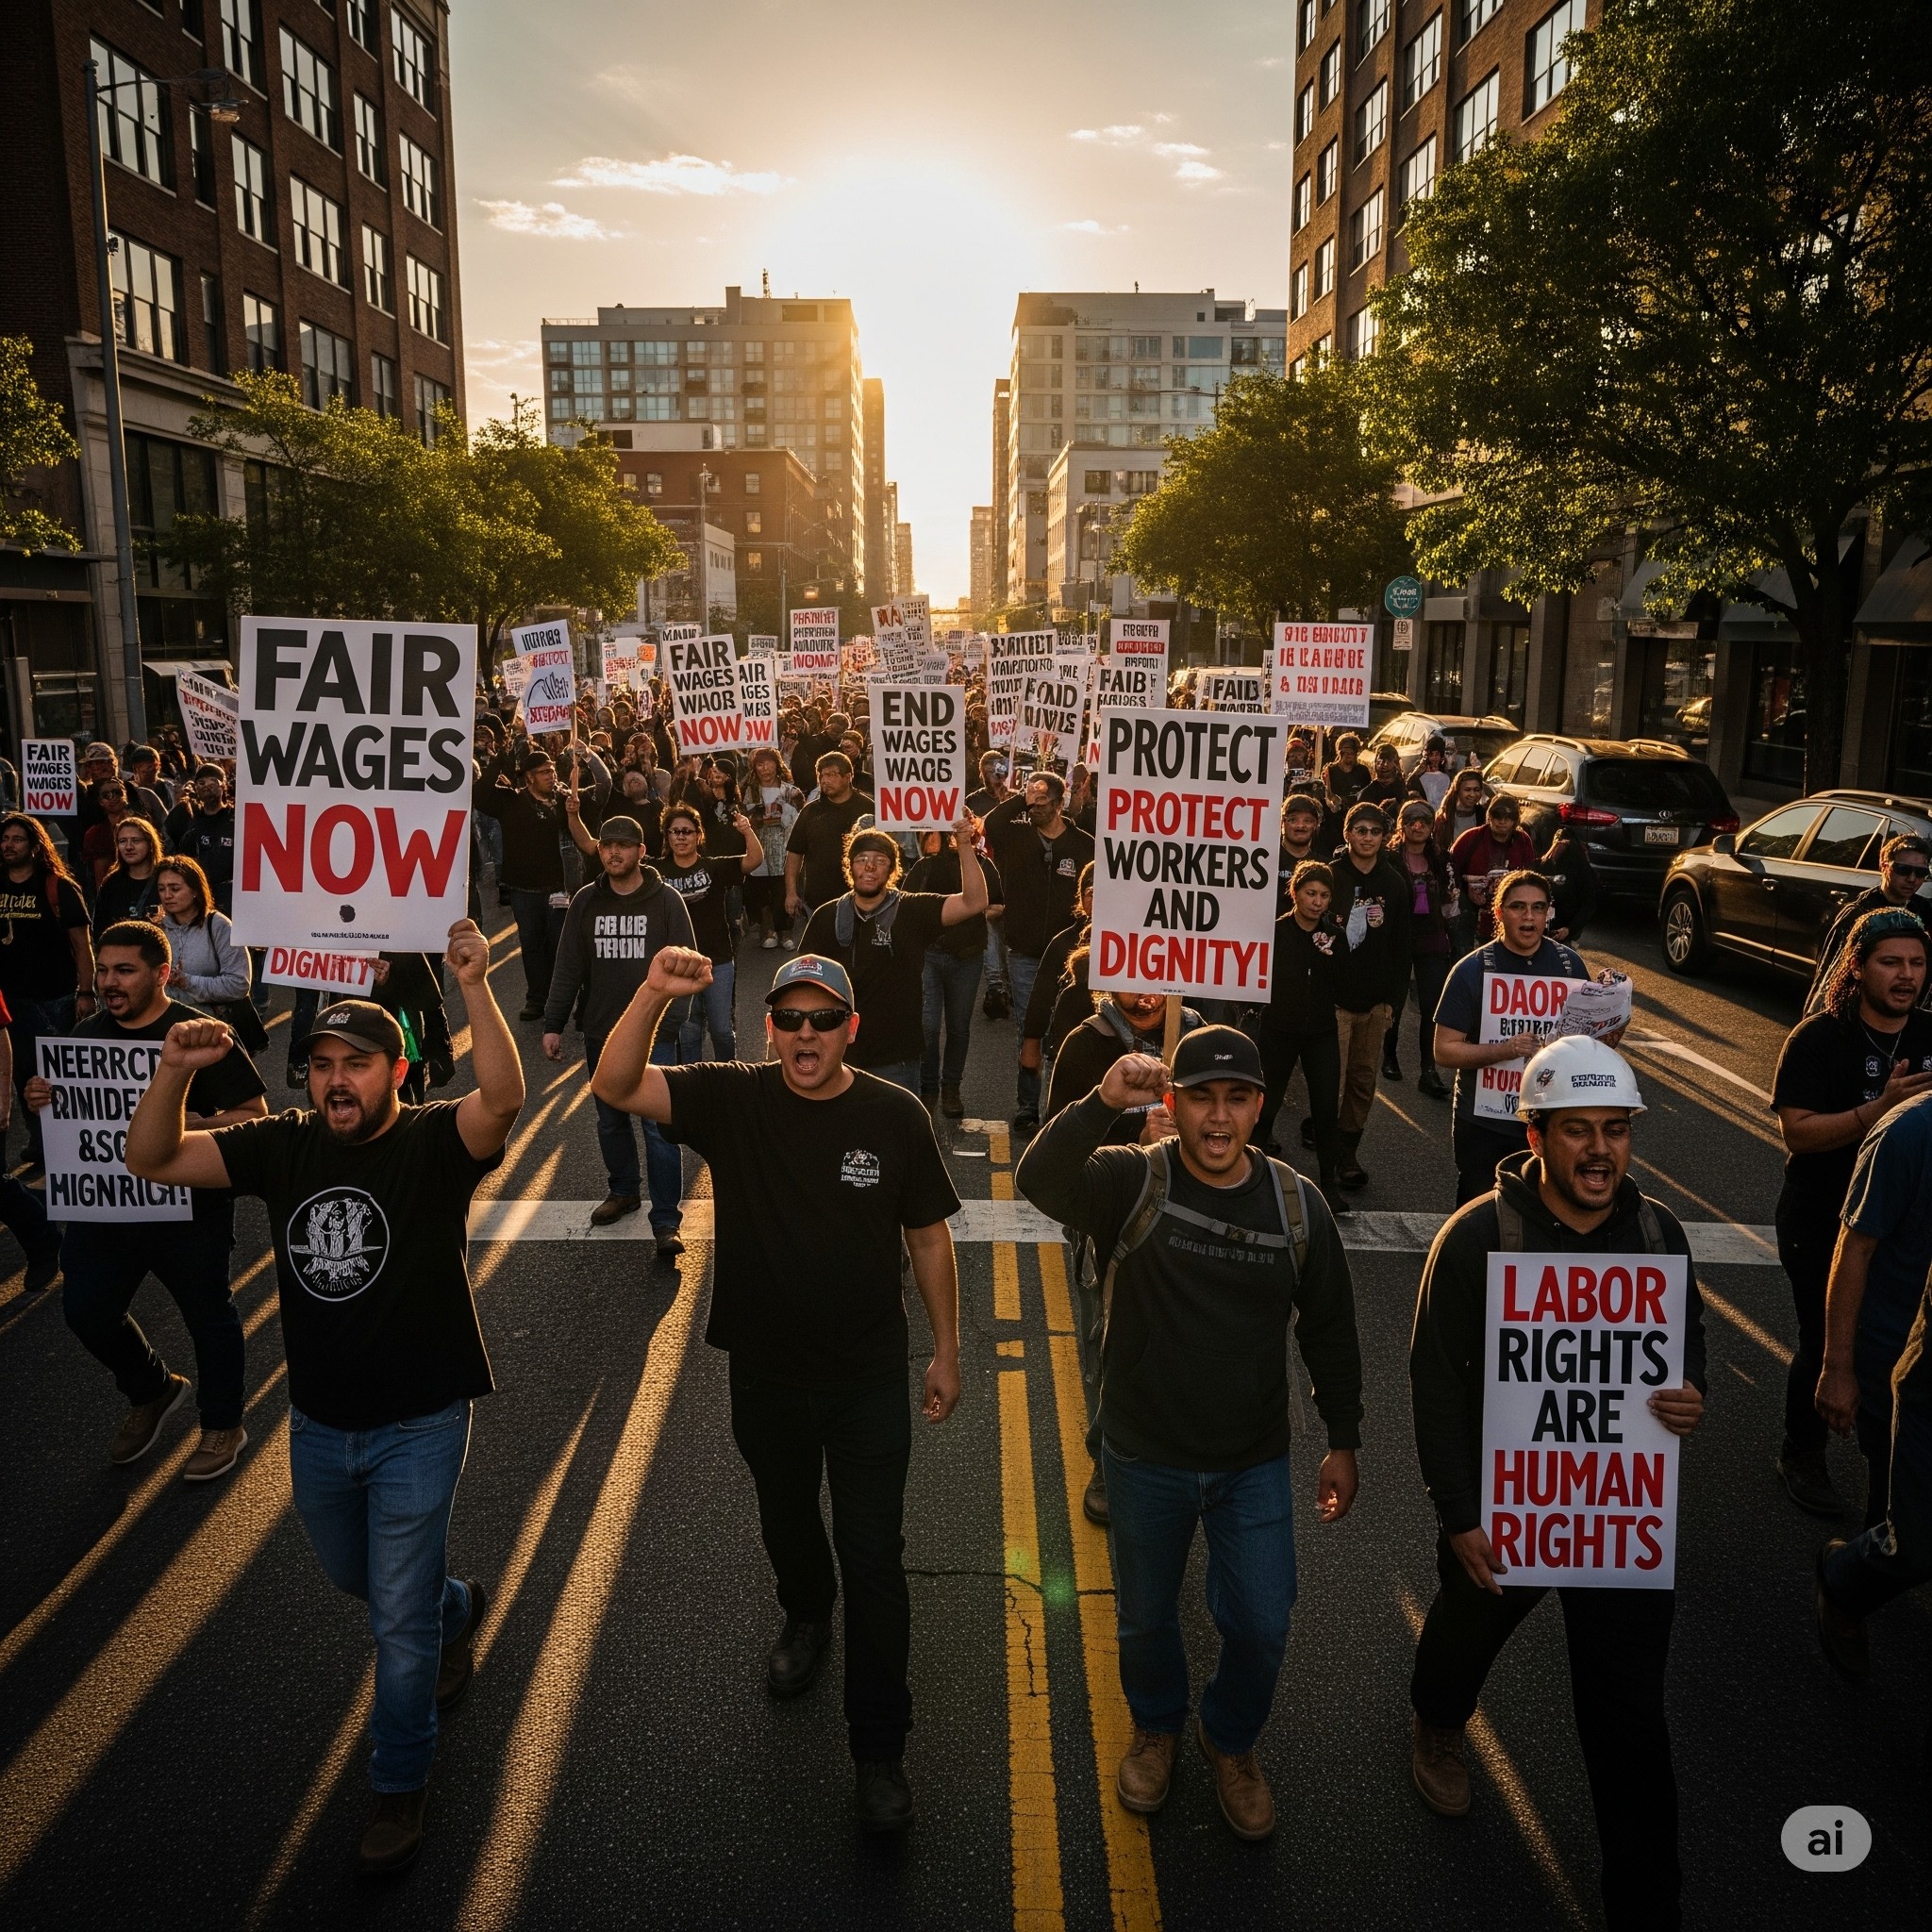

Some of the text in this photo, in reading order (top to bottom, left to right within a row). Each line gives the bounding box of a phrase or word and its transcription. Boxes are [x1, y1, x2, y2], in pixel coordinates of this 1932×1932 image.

[255, 628, 461, 718] FAIR
[669, 641, 731, 671] FAIR
[673, 668, 734, 691] WAGES
[739, 663, 766, 683] AIR
[741, 684, 770, 699] GES
[882, 691, 955, 726] END
[27, 743, 70, 761] FAIR
[679, 713, 742, 746] NOW
[881, 730, 958, 754] WAGES
[1108, 717, 1277, 785] PROTECT
[240, 720, 466, 793] WAGES
[27, 792, 74, 810] NOW
[880, 787, 959, 822] NOW
[1108, 788, 1270, 841] PROTECT
[242, 803, 467, 897] NOW
[1103, 837, 1270, 891] WORKERS
[1142, 887, 1220, 932] AND
[1099, 930, 1270, 990] DIGNITY!
[1503, 1265, 1668, 1324] LABOR
[1498, 1327, 1669, 1386] RIGHTS
[1531, 1390, 1624, 1443] ARE
[1492, 1449, 1665, 1508] HUMAN
[1491, 1511, 1663, 1571] RIGHTS
